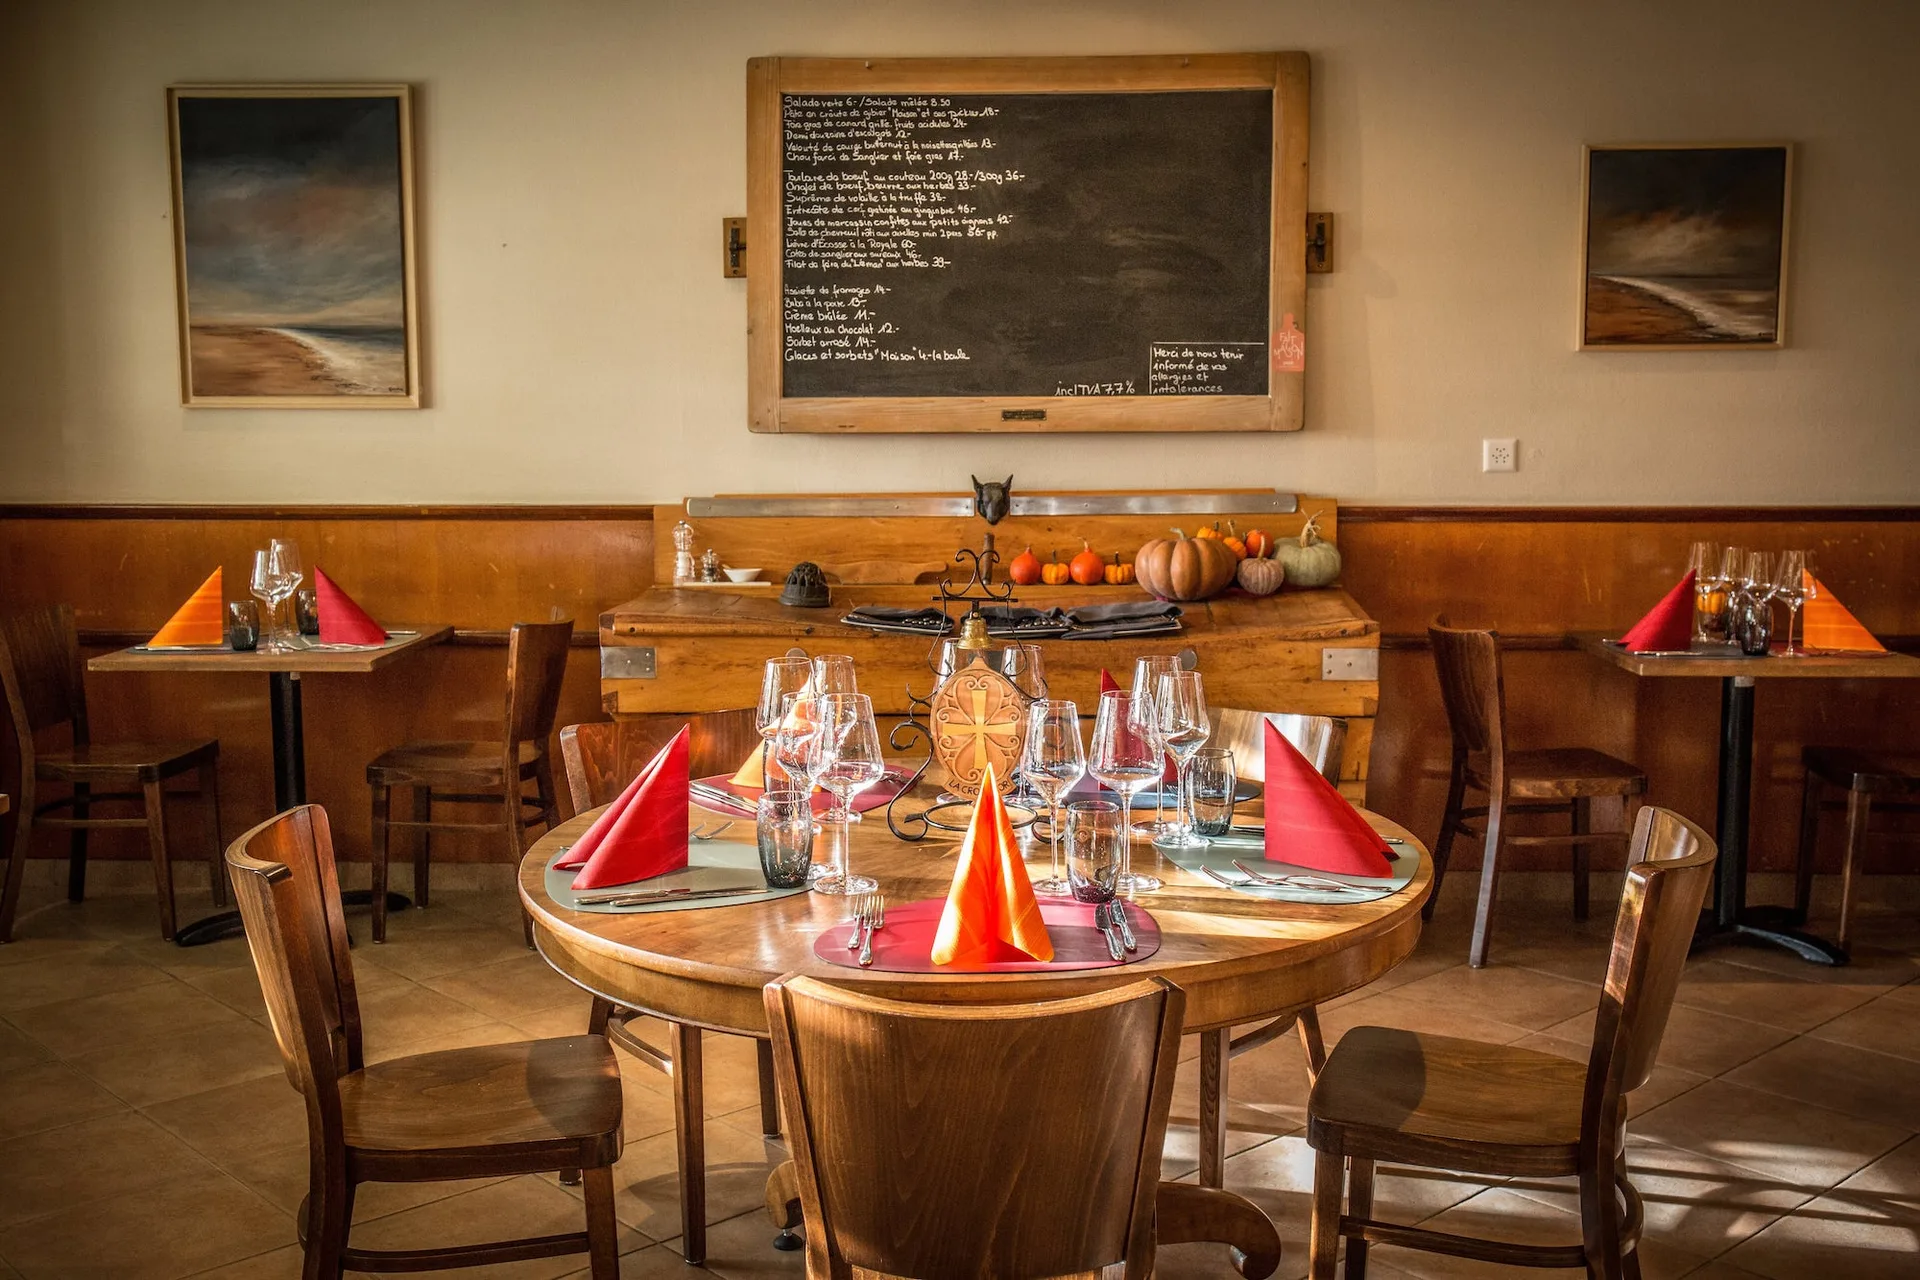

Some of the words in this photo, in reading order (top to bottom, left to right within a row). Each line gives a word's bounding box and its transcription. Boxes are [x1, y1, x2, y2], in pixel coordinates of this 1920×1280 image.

[784, 96, 820, 107] Salade
[821, 98, 843, 107] verte
[930, 98, 951, 106] 8.50
[849, 109, 861, 117] de
[863, 108, 887, 120] gibier
[921, 108, 930, 118] et
[803, 122, 821, 131] gras
[824, 119, 834, 127] de
[836, 119, 867, 128] canard
[895, 118, 915, 131] fruits
[784, 130, 809, 140] Demi
[809, 130, 846, 139] douzaine
[786, 142, 820, 151] Velouté
[822, 143, 834, 152] de
[836, 144, 863, 153] courge
[904, 141, 910, 150] à
[912, 140, 919, 149] la
[786, 152, 810, 161] Chou
[812, 152, 836, 166] farci
[839, 153, 850, 161] de
[892, 151, 902, 161] et
[905, 151, 922, 165] foie
[925, 153, 943, 164] gras
[826, 172, 839, 181] de
[841, 170, 869, 184] boeuf
[888, 171, 926, 181] couteau
[929, 170, 953, 185] 200g
[786, 181, 816, 195] Onglet
[819, 182, 833, 190] de
[867, 182, 904, 190] beurre
[923, 182, 955, 190] herbes
[787, 192, 831, 204] Suprême
[833, 193, 847, 202] de
[848, 192, 880, 202] volaille
[880, 191, 887, 201] à
[889, 192, 897, 201] la
[899, 192, 927, 204] truffe
[784, 204, 830, 215] Entrecôte
[832, 205, 844, 213] de
[787, 217, 812, 227] Joues
[814, 218, 825, 226] de
[827, 219, 873, 227] marcassin
[873, 215, 910, 228] confites
[929, 218, 959, 229] petits
[808, 228, 819, 236] de
[820, 227, 859, 237] chevreuil
[861, 227, 875, 237] rôti
[922, 229, 937, 237] min
[849, 239, 856, 248] à
[857, 239, 866, 249] la
[867, 238, 898, 252] Royale
[808, 250, 820, 258] de
[820, 249, 853, 259] sanglier
[870, 250, 901, 258] sureaux
[785, 259, 807, 268] Filet
[808, 260, 819, 268] de
[841, 260, 851, 268] du
[901, 259, 929, 268] herbes
[784, 284, 815, 295] Assiette
[819, 286, 829, 294] de
[832, 284, 871, 298] fromages
[784, 297, 804, 308] Baba
[804, 296, 811, 307] à
[814, 298, 822, 308] la
[823, 299, 845, 311] poire
[784, 309, 814, 320] Crème
[817, 309, 848, 321] brûlée
[784, 323, 821, 334] Moelleux
[824, 326, 835, 334] au
[878, 322, 900, 334] 12.-
[786, 336, 816, 347] Sorbet
[820, 335, 851, 347] arrosé
[855, 336, 876, 347] 14.-
[784, 348, 818, 361] Glaces
[820, 349, 832, 359] et
[835, 349, 874, 361] sorbets
[943, 348, 970, 361] boule
[1153, 346, 1179, 358] Merci
[1181, 348, 1195, 358] de
[1196, 350, 1218, 358] nous
[1220, 348, 1244, 360] tenir
[1153, 359, 1195, 371] informé
[1196, 362, 1209, 371] de
[1151, 371, 1193, 385] allergies
[1196, 371, 1209, 381] et
[1077, 383, 1101, 395] TVA
[1153, 380, 1223, 394] intolérances
[948, 779, 960, 791] LA
[961, 785, 980, 796] CRO
